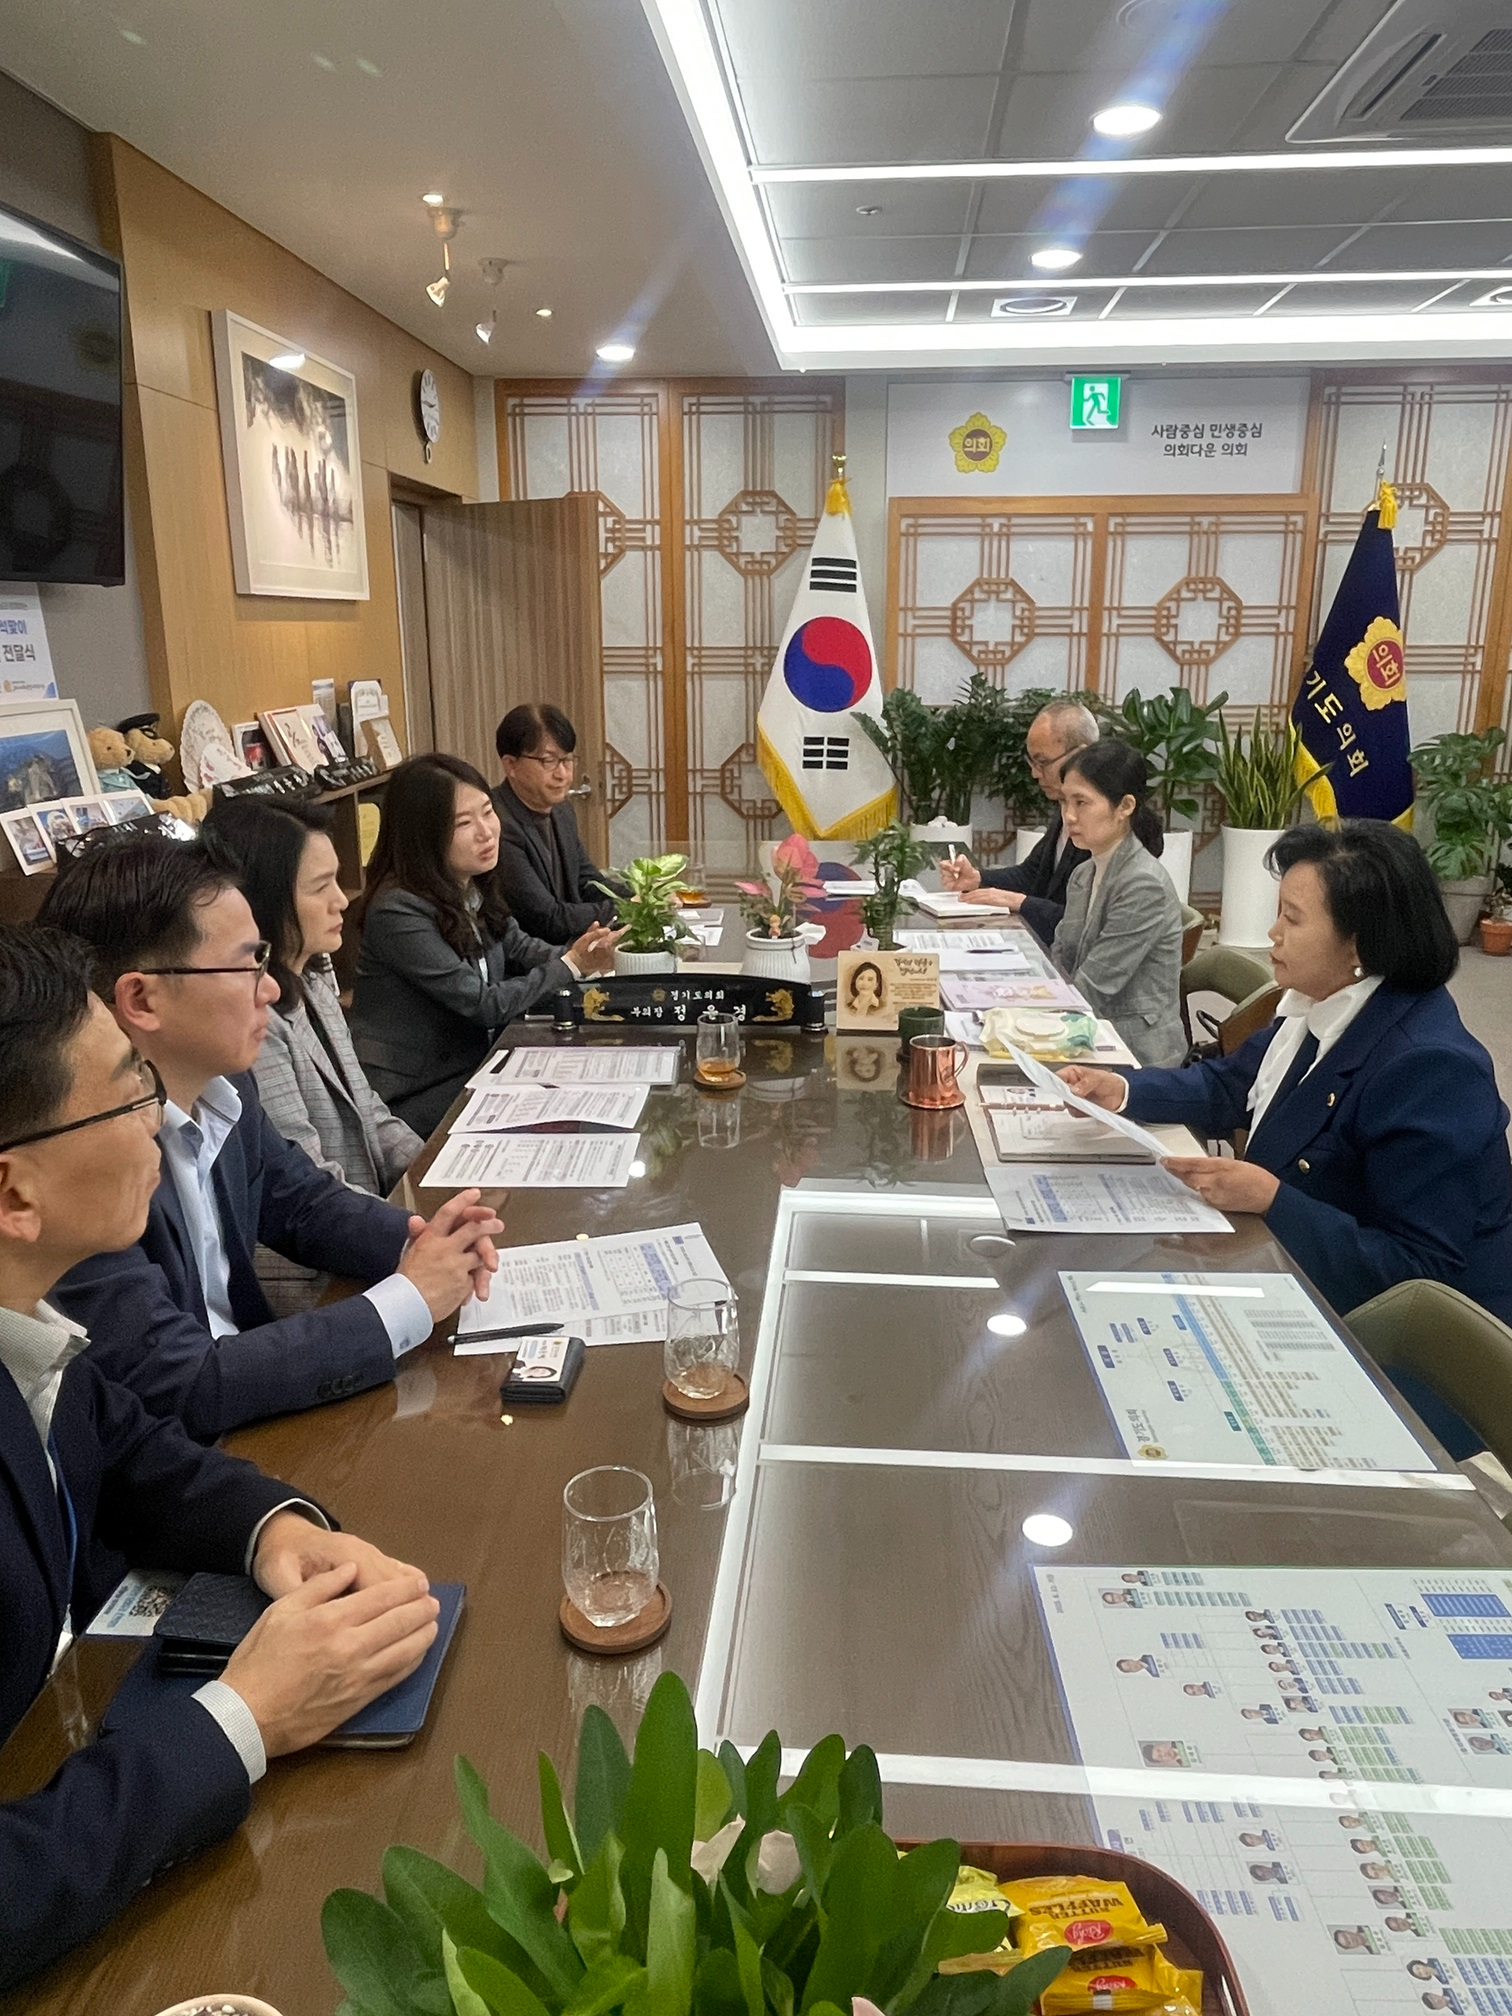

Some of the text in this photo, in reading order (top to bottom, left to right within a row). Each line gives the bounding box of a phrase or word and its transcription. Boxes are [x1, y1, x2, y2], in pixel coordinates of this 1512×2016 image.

[1151, 423, 1262, 440] 사람중심 민생중심
[964, 437, 990, 453] 의회
[1163, 442, 1248, 458] 의회다운 의회
[2, 644, 36, 662] 전달식
[1372, 644, 1401, 686] 의회
[670, 989, 725, 1001] 경기도의회
[631, 1006, 664, 1018] 부의장
[1028, 1897, 1125, 1916] WAFFLES
